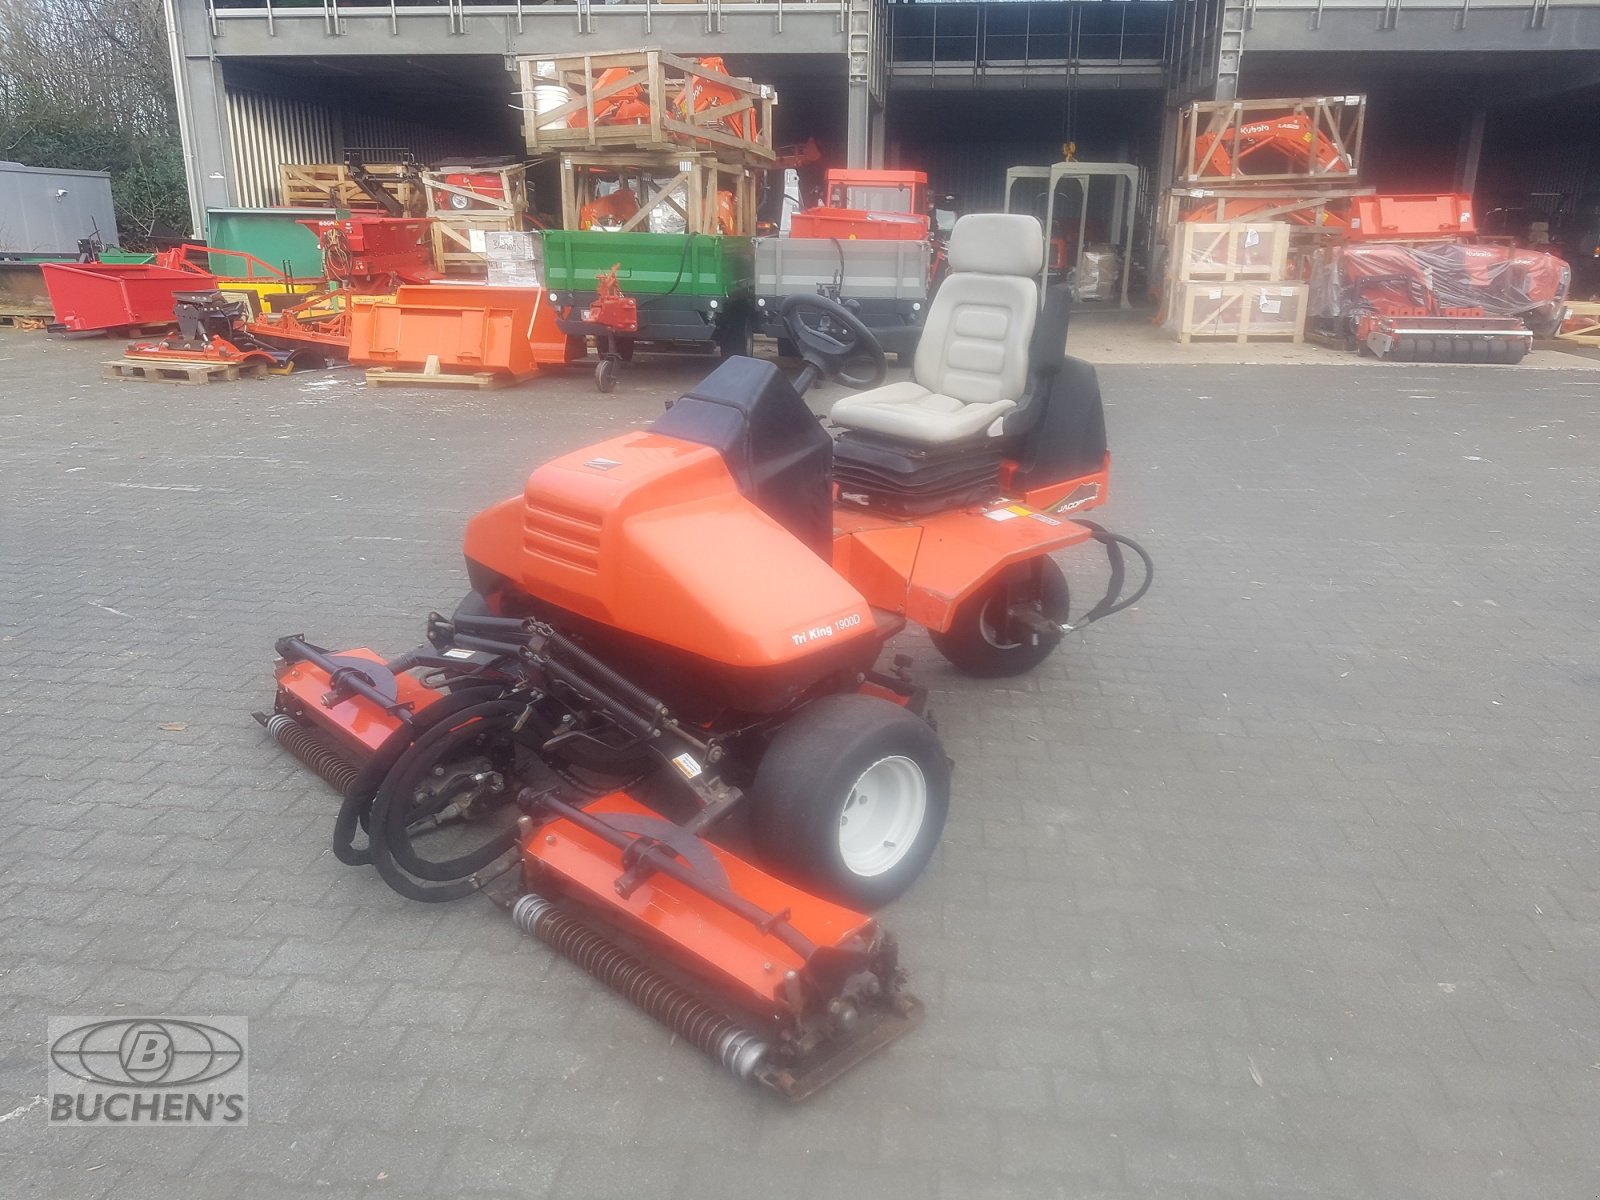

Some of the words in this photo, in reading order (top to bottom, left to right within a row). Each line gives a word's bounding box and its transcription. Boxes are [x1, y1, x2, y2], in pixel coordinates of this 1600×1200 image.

[1240, 124, 1269, 134] Kubota
[792, 632, 807, 646] Tri
[809, 626, 832, 640] King
[835, 614, 860, 630] 1900D
